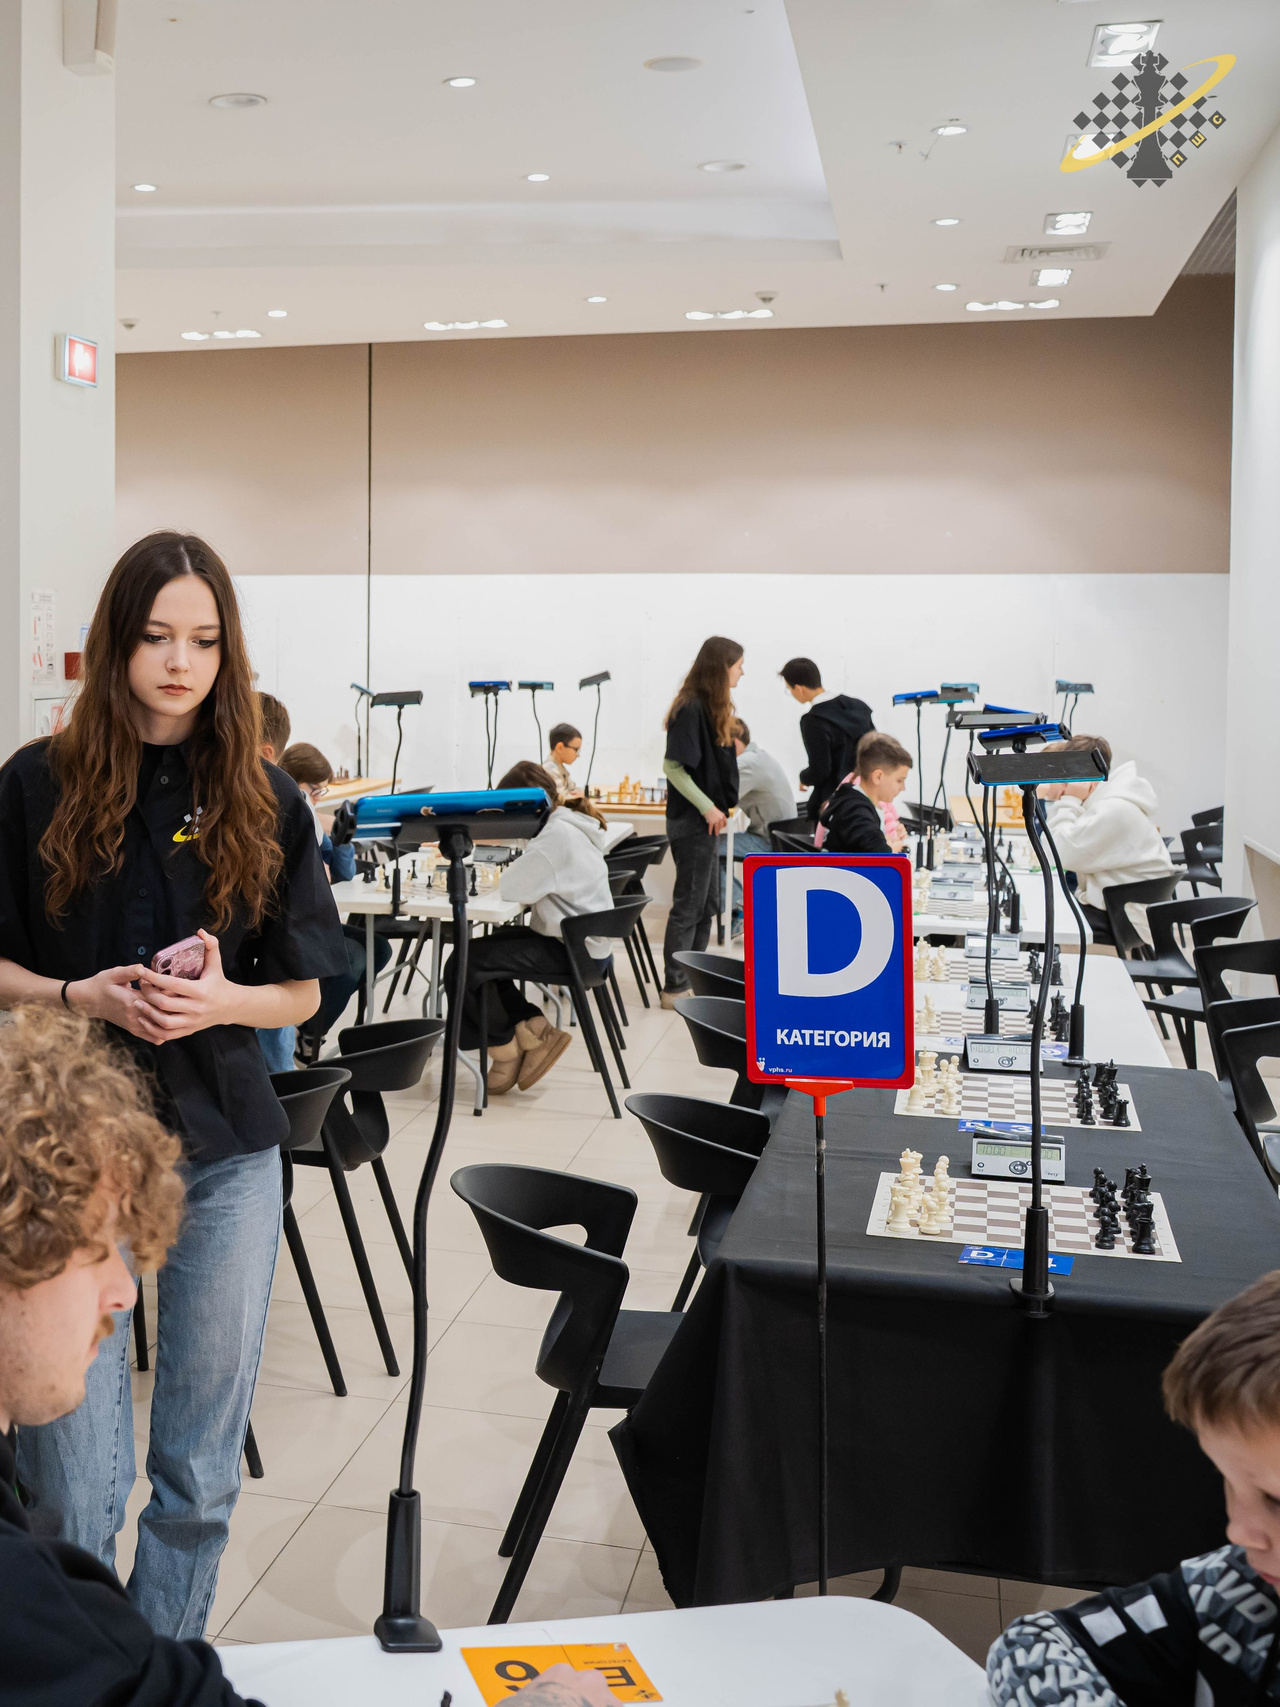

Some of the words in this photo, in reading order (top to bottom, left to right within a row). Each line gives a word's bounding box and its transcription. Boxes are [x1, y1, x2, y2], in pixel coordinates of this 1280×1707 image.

[776, 866, 895, 998] D
[776, 1028, 891, 1048] КАТЕГОРИЯ
[970, 1250, 995, 1258] D
